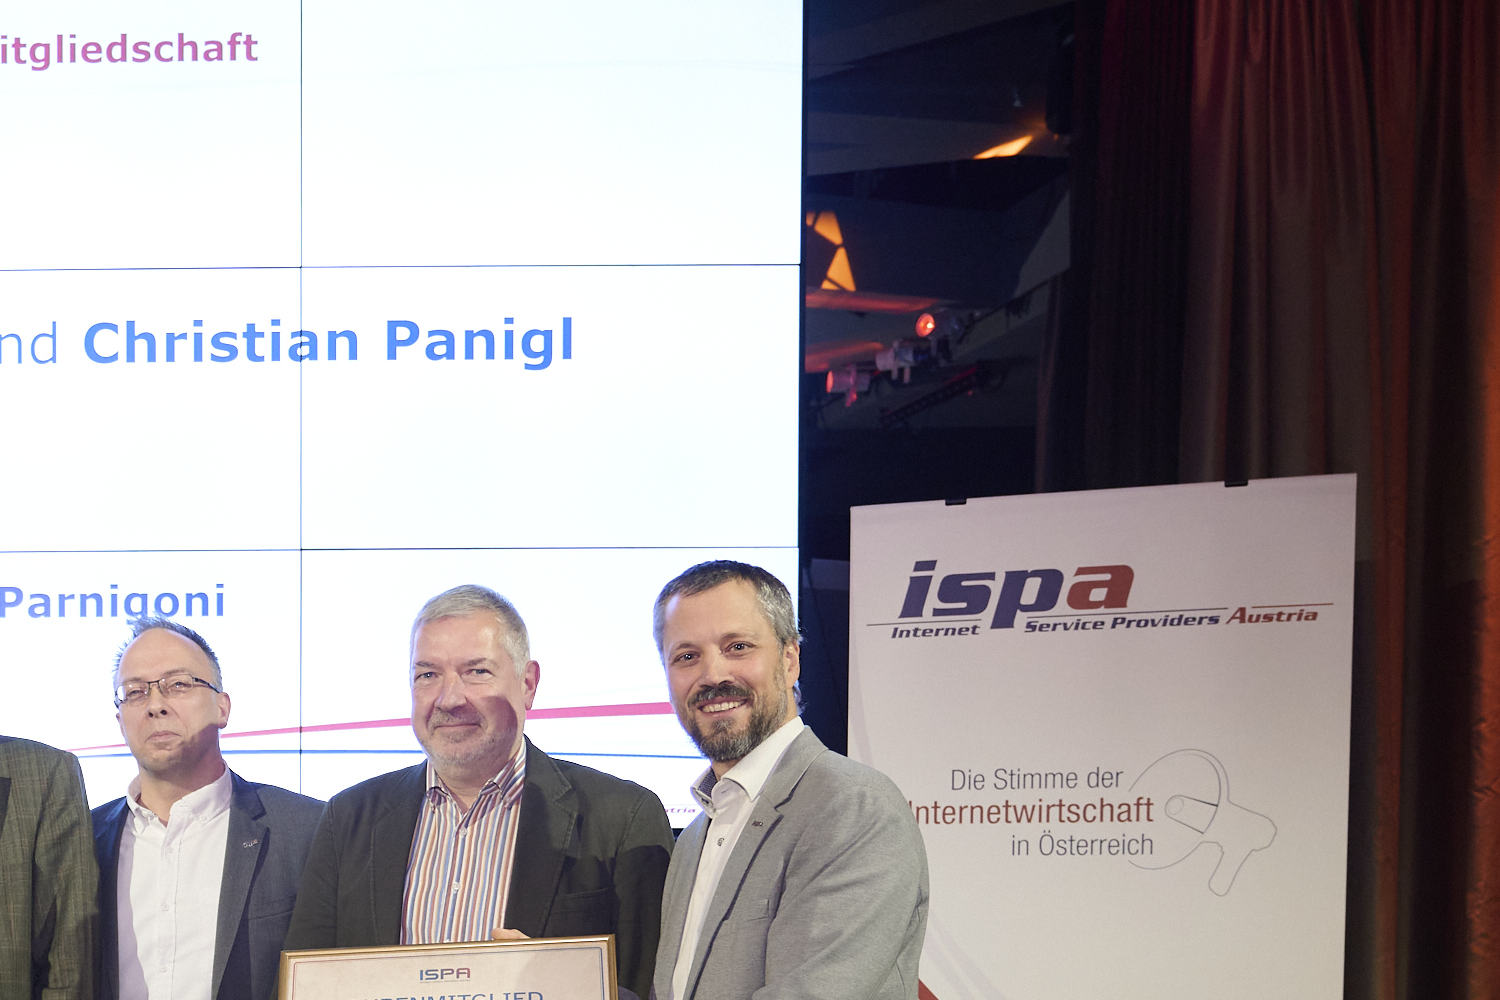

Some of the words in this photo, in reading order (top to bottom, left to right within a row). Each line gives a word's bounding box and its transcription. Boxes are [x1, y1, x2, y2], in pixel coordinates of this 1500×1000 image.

[84, 319, 358, 364] Christian
[387, 317, 573, 371] Panigl
[898, 560, 1135, 630] ispa
[891, 623, 980, 639] Internet
[1024, 617, 1105, 634] Service
[1110, 612, 1220, 630] Providers
[1226, 606, 1319, 626] Austria
[951, 769, 985, 791] Die
[993, 768, 1078, 791] Stimme
[1086, 766, 1124, 789] der
[1011, 834, 1029, 856] in
[1038, 830, 1154, 856] Österreich
[419, 967, 471, 980] ISPA
